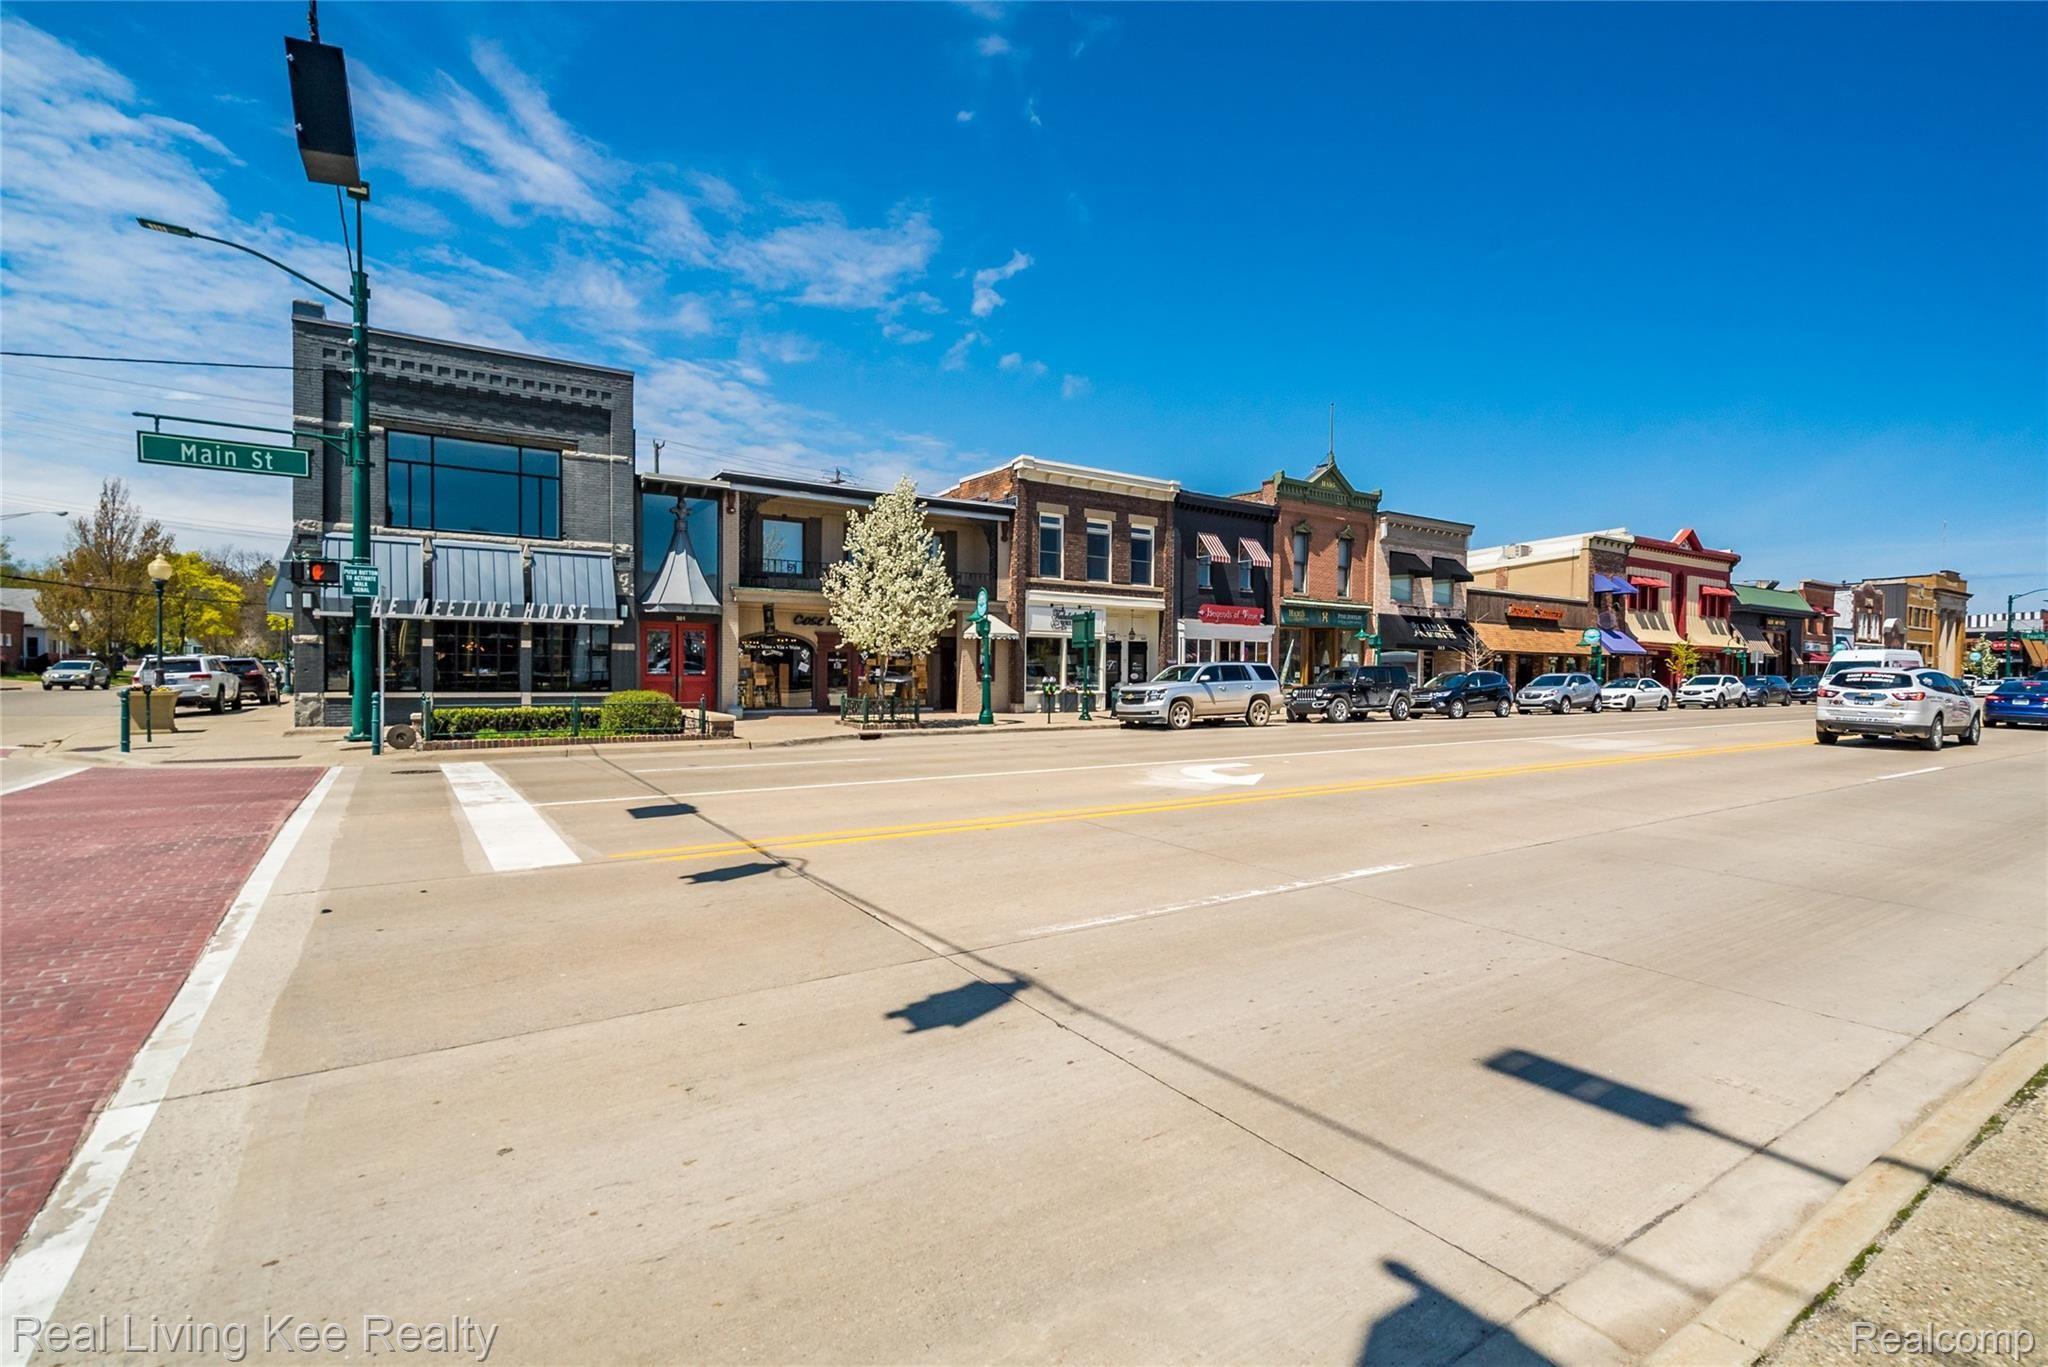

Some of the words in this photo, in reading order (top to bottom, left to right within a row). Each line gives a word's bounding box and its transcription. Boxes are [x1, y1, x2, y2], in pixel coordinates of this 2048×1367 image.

[180, 443, 237, 466] Main
[251, 451, 273, 470] St
[371, 597, 400, 616] HE
[413, 598, 511, 619] MEETING
[523, 602, 589, 621] HOUSE
